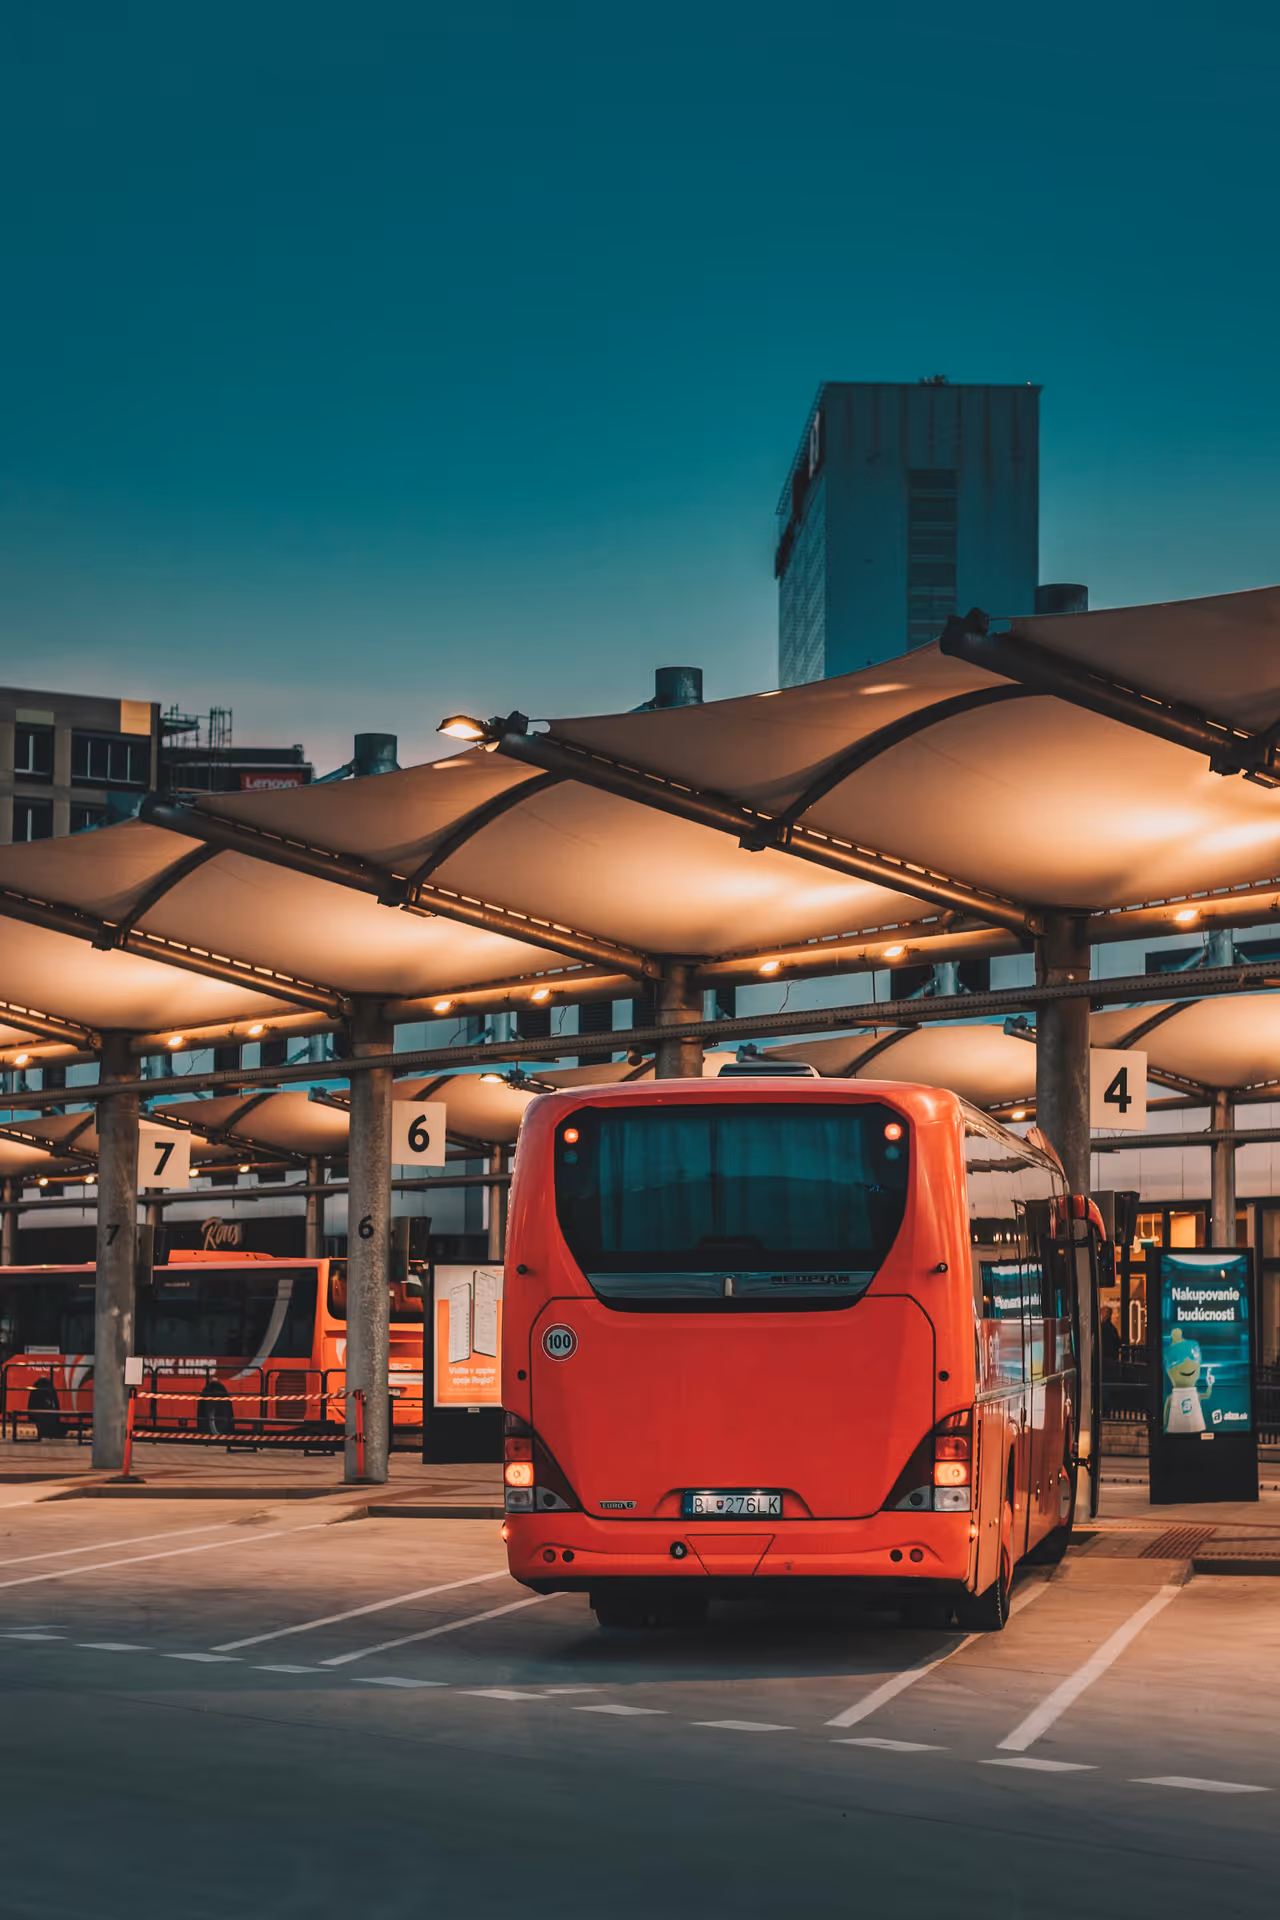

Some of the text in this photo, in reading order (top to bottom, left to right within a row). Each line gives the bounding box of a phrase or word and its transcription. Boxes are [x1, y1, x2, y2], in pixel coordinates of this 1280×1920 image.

[245, 777, 298, 789] Lenovo
[1103, 1066, 1132, 1113] 4
[407, 1113, 430, 1152] 6
[153, 1141, 175, 1176] 7
[106, 1224, 120, 1246] 7
[358, 1215, 374, 1239] 6
[1171, 1287, 1240, 1304] Nakupovanie
[1177, 1306, 1235, 1321] budúcnosti
[548, 1334, 571, 1349] 100
[602, 1501, 634, 1509] EURO 6
[694, 1497, 778, 1513] BL 276LK
